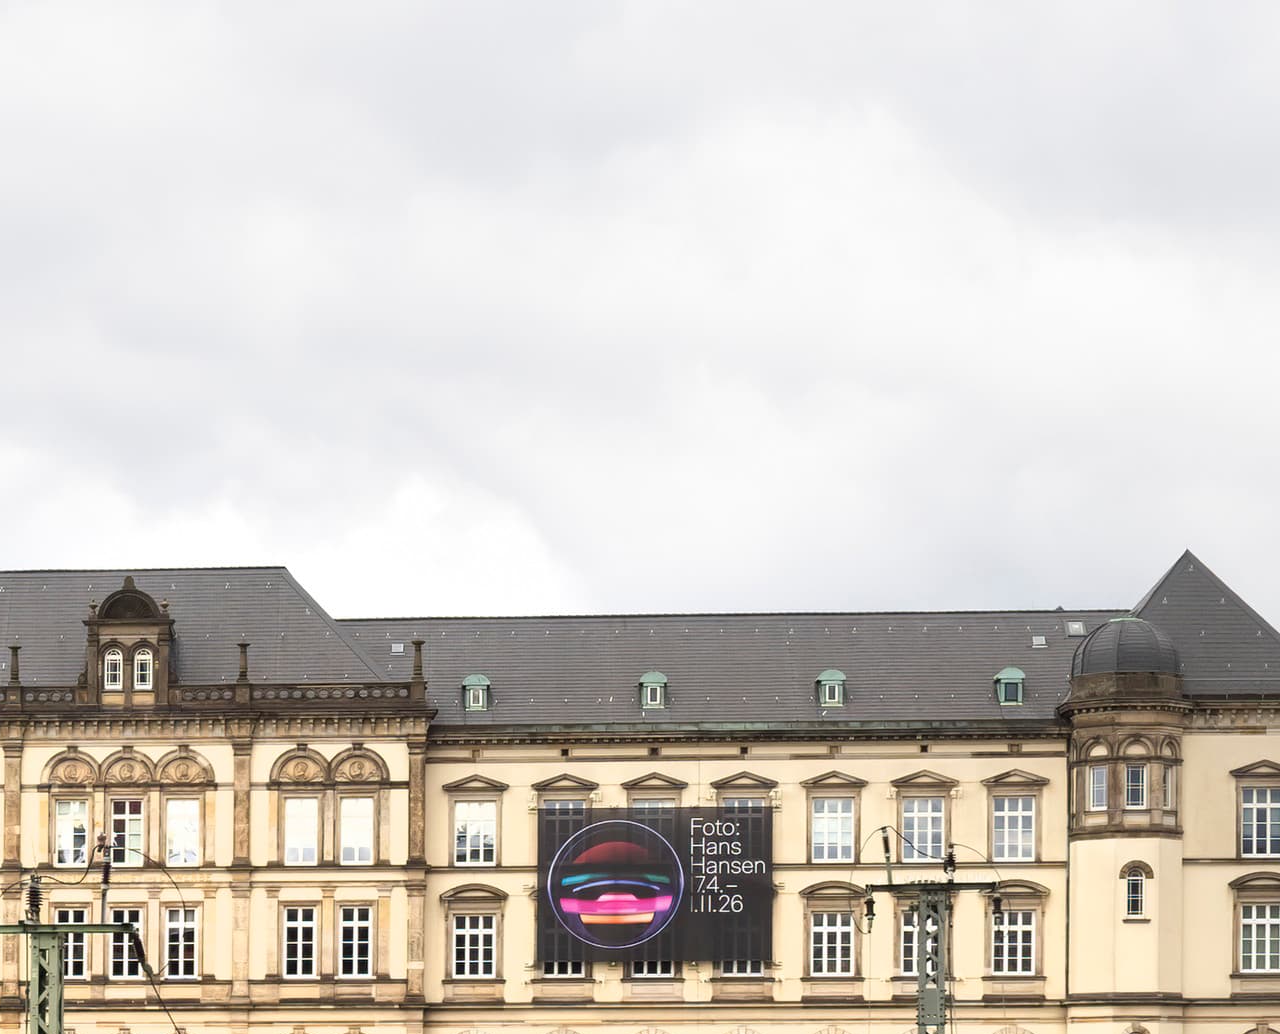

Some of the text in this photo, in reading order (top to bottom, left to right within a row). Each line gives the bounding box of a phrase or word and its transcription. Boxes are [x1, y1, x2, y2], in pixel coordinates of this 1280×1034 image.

[690, 817, 740, 836] Foto:
[690, 837, 742, 855] Hans
[690, 856, 766, 875] Hansen
